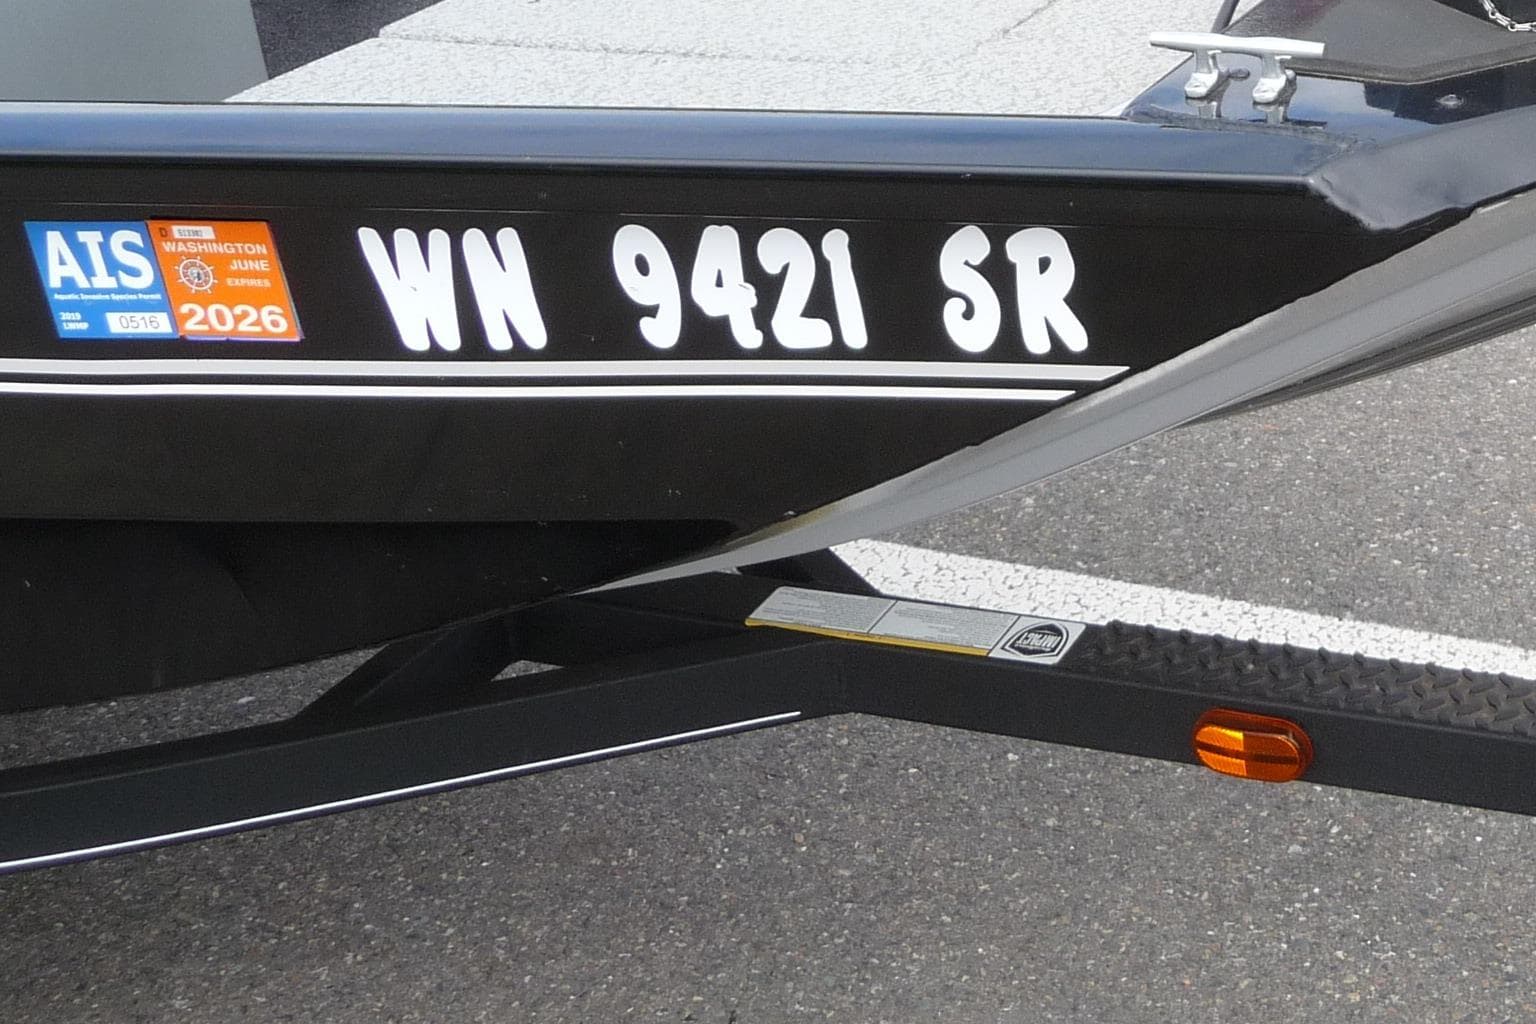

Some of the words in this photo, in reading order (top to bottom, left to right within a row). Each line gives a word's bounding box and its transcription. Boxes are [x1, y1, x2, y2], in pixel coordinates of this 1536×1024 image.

[162, 241, 268, 255] WASHINGTON
[46, 229, 154, 289] AIS
[230, 259, 271, 271] JUNE
[226, 277, 272, 288] EXPIRES
[357, 226, 548, 351] WN
[612, 224, 868, 350] 9421
[939, 224, 1089, 355] SR
[119, 315, 160, 330] 0516
[180, 303, 288, 333] 2026
